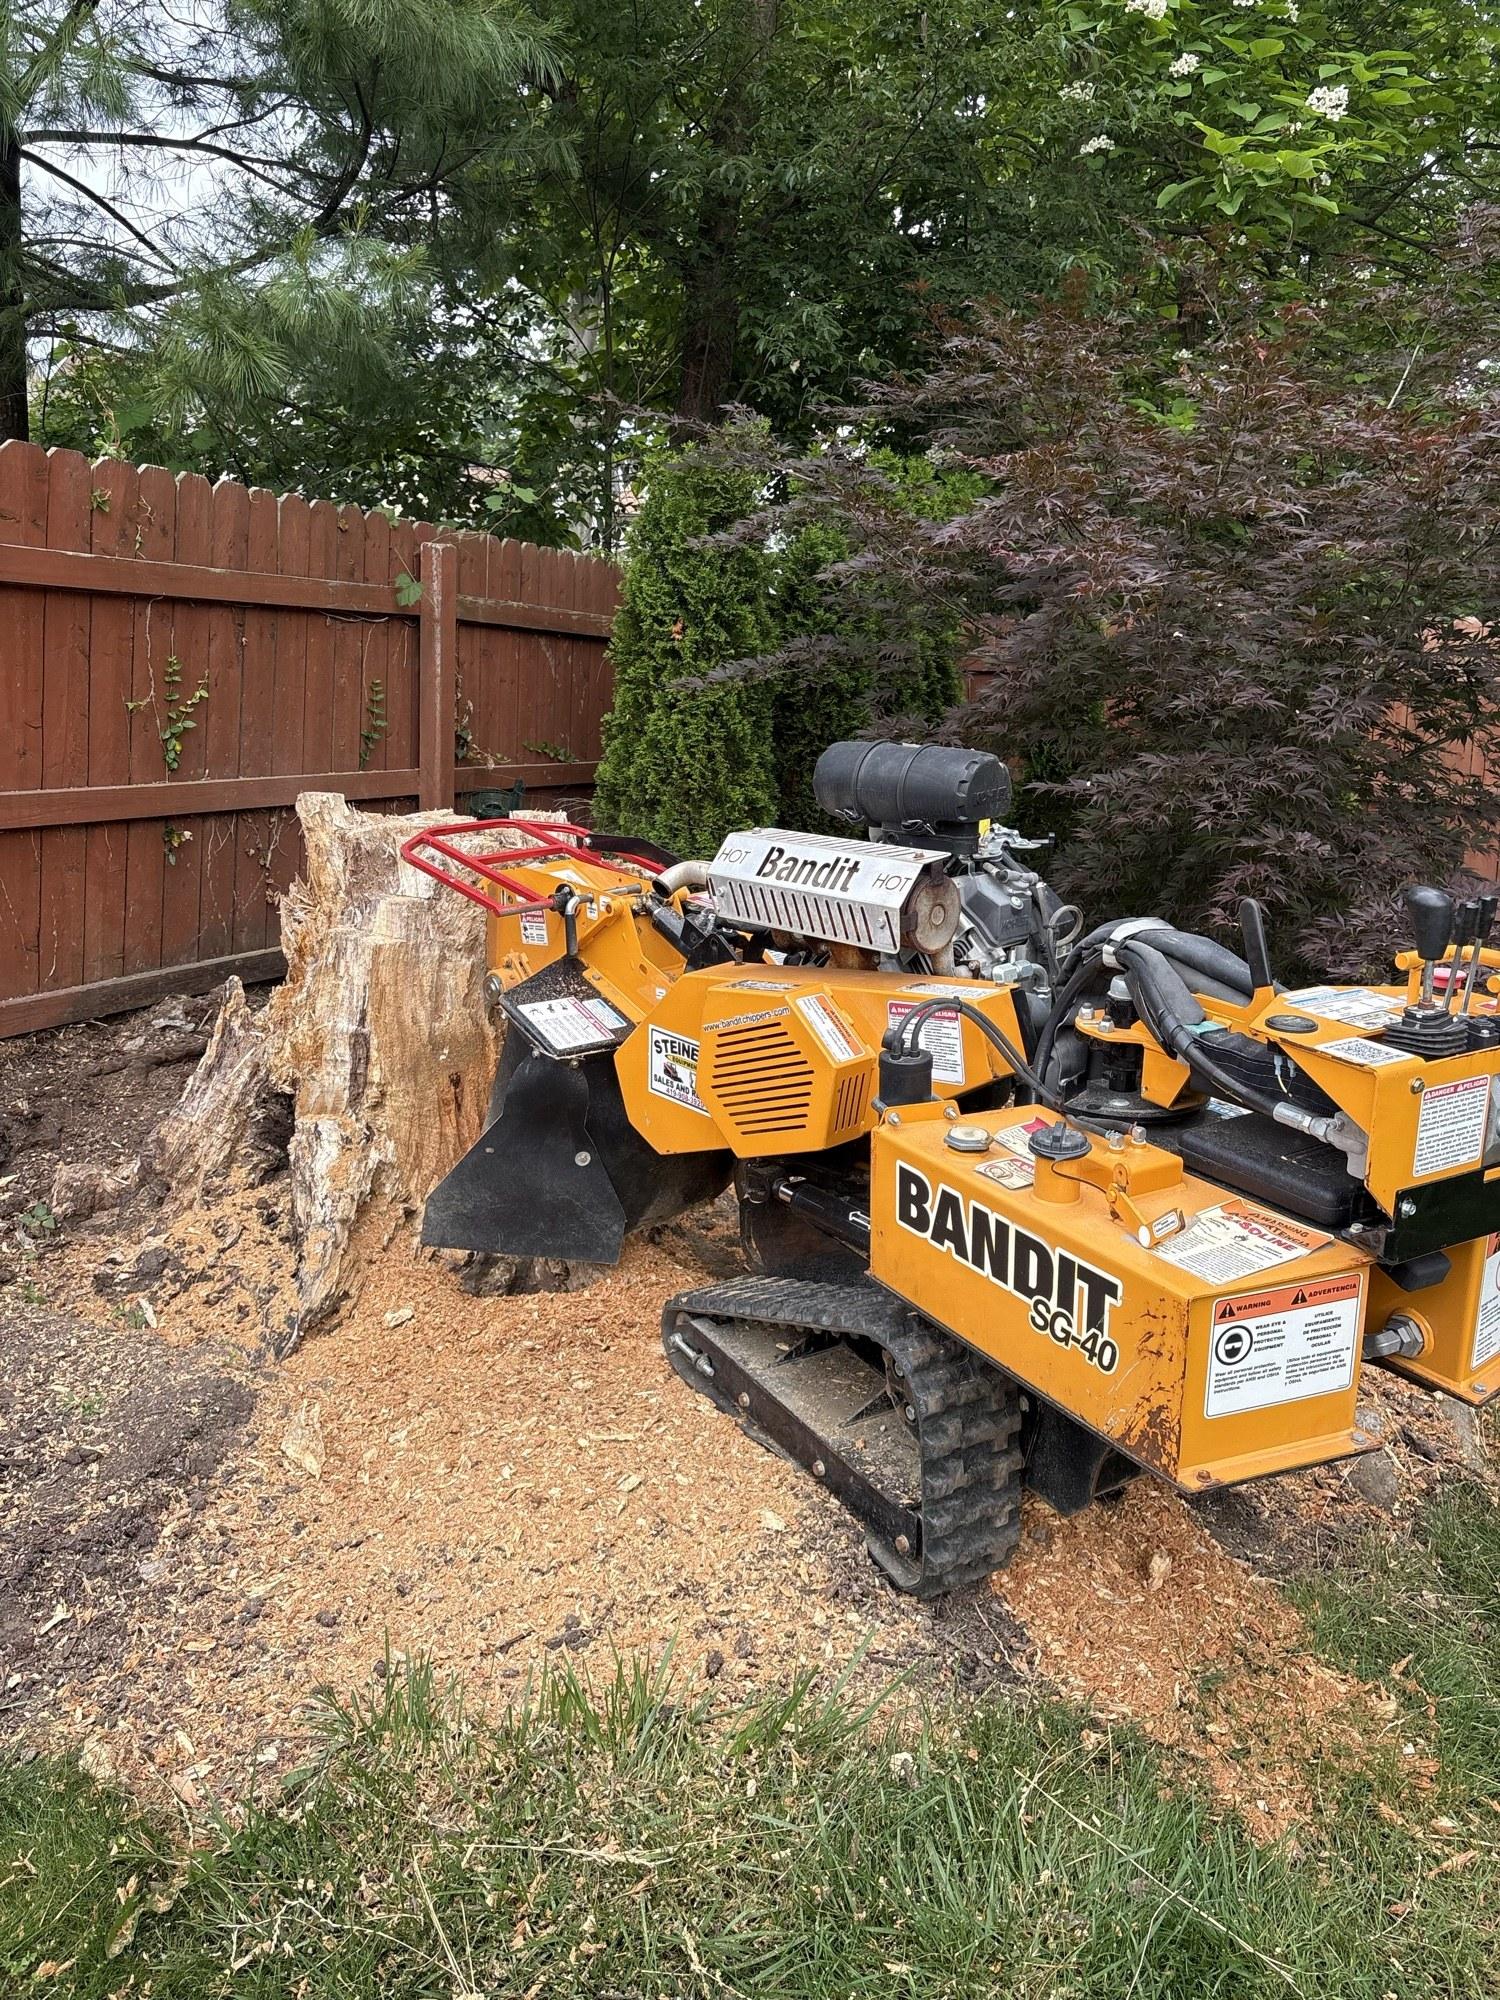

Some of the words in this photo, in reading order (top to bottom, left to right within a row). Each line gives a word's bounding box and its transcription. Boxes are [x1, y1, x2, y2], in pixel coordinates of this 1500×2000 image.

[717, 848, 751, 864] HOT
[756, 846, 861, 893] Bandit
[872, 872, 912, 892] HOT
[704, 1007, 789, 1031] www.banditchippers.com
[654, 1074, 674, 1088] SALES
[676, 1083, 689, 1094] AND
[1432, 1087, 1454, 1097] DANGER
[1464, 1079, 1487, 1089] PELIGRO
[1262, 1216, 1309, 1237] WARNING
[897, 1162, 1120, 1338] BANDIT
[1236, 1300, 1271, 1312] WARNING
[1308, 1284, 1356, 1298] ADVERTENCIA
[1305, 1316, 1341, 1327] EQUIPAMIENTO
[1030, 1299, 1117, 1372] SG-40
[1254, 1335, 1285, 1344] PROTECTION
[1257, 1328, 1283, 1336] PERSONAL
[1307, 1333, 1331, 1341] PERSONAL
[1254, 1343, 1283, 1352] EQUIPMENT
